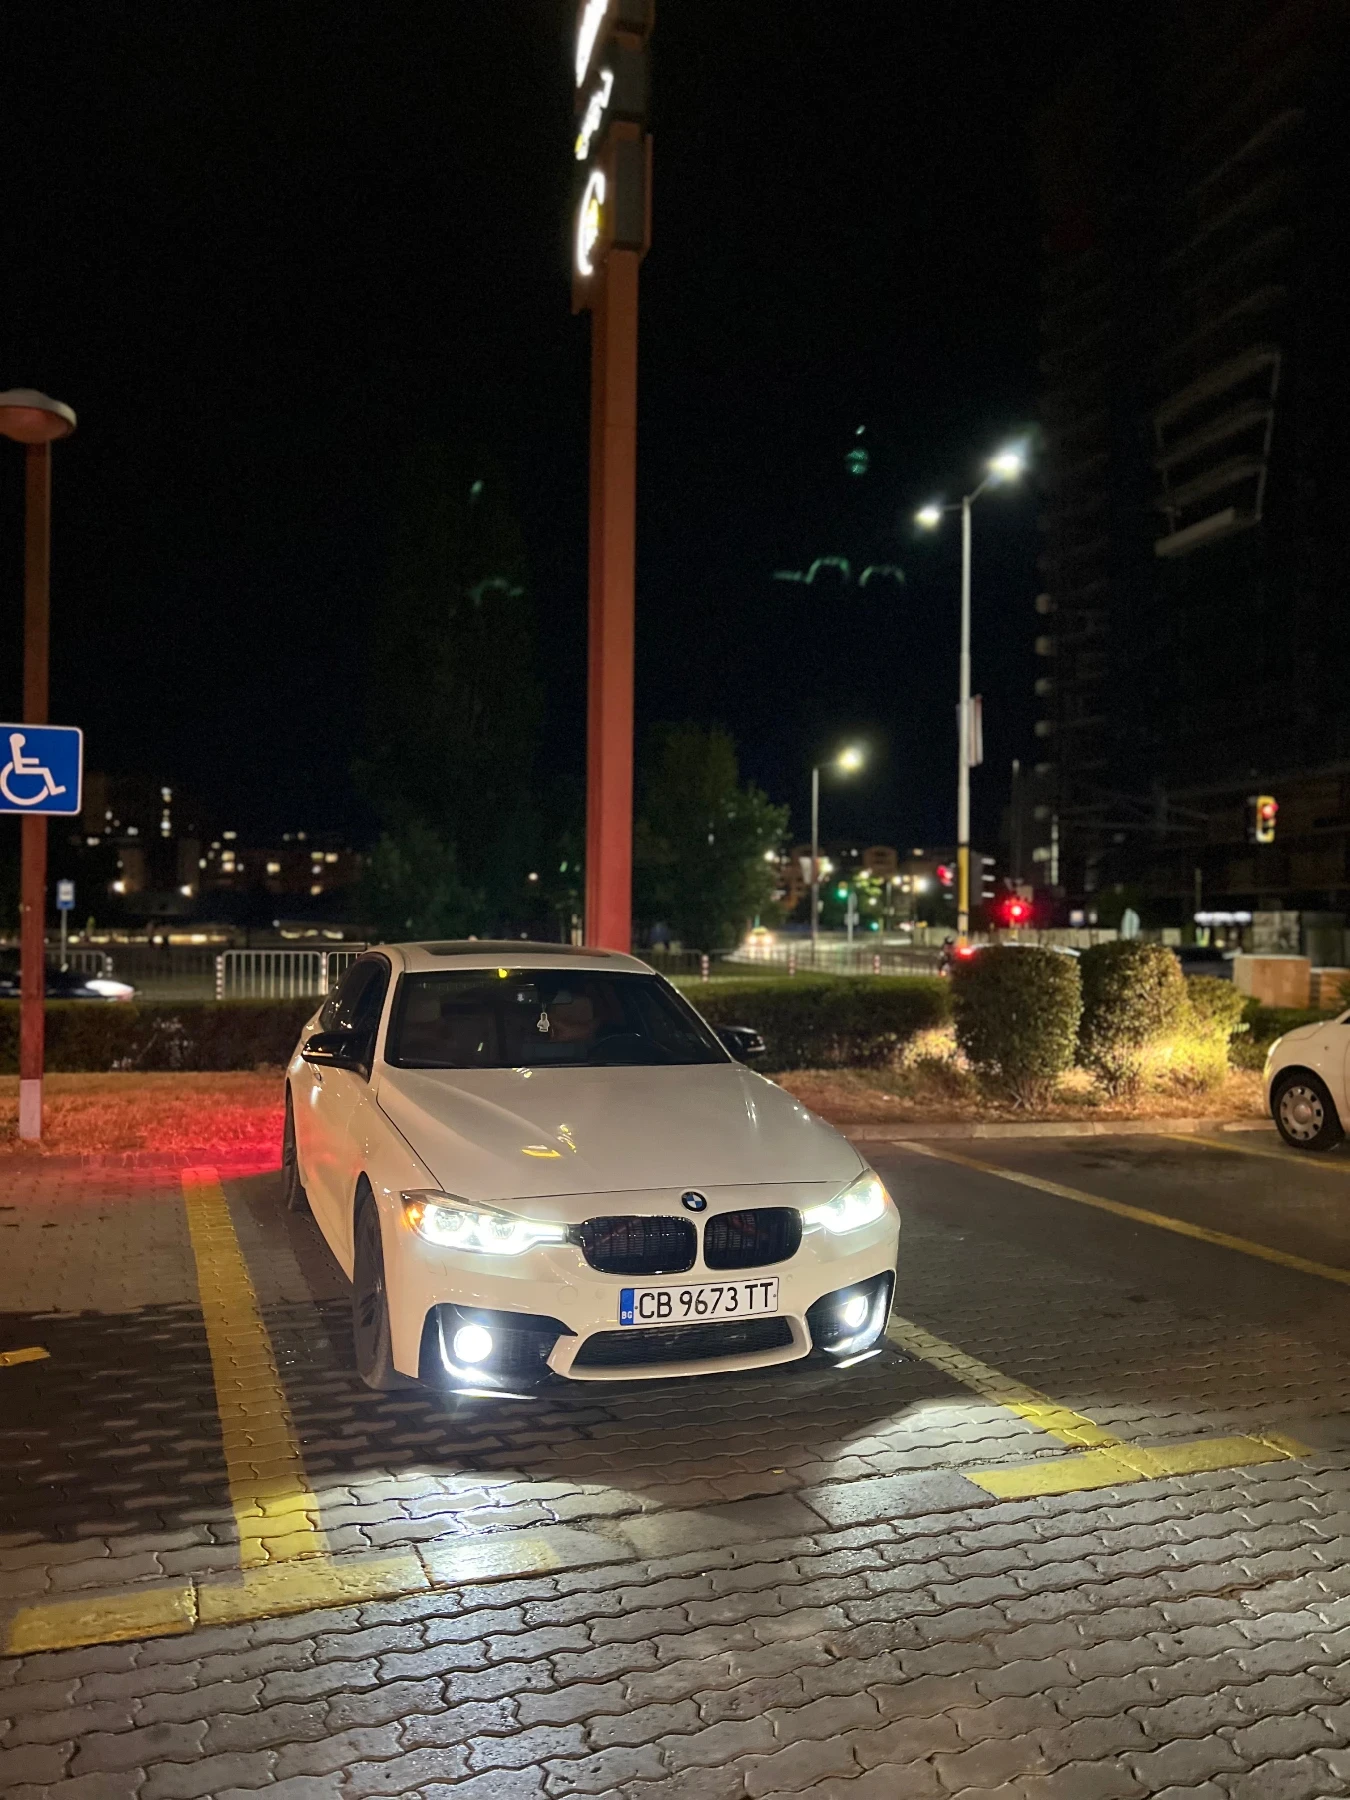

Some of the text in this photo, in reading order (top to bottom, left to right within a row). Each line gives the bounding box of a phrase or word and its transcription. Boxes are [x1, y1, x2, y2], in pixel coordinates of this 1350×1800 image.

[639, 1282, 774, 1318] CB 9673 TT
[621, 1311, 633, 1319] BG
